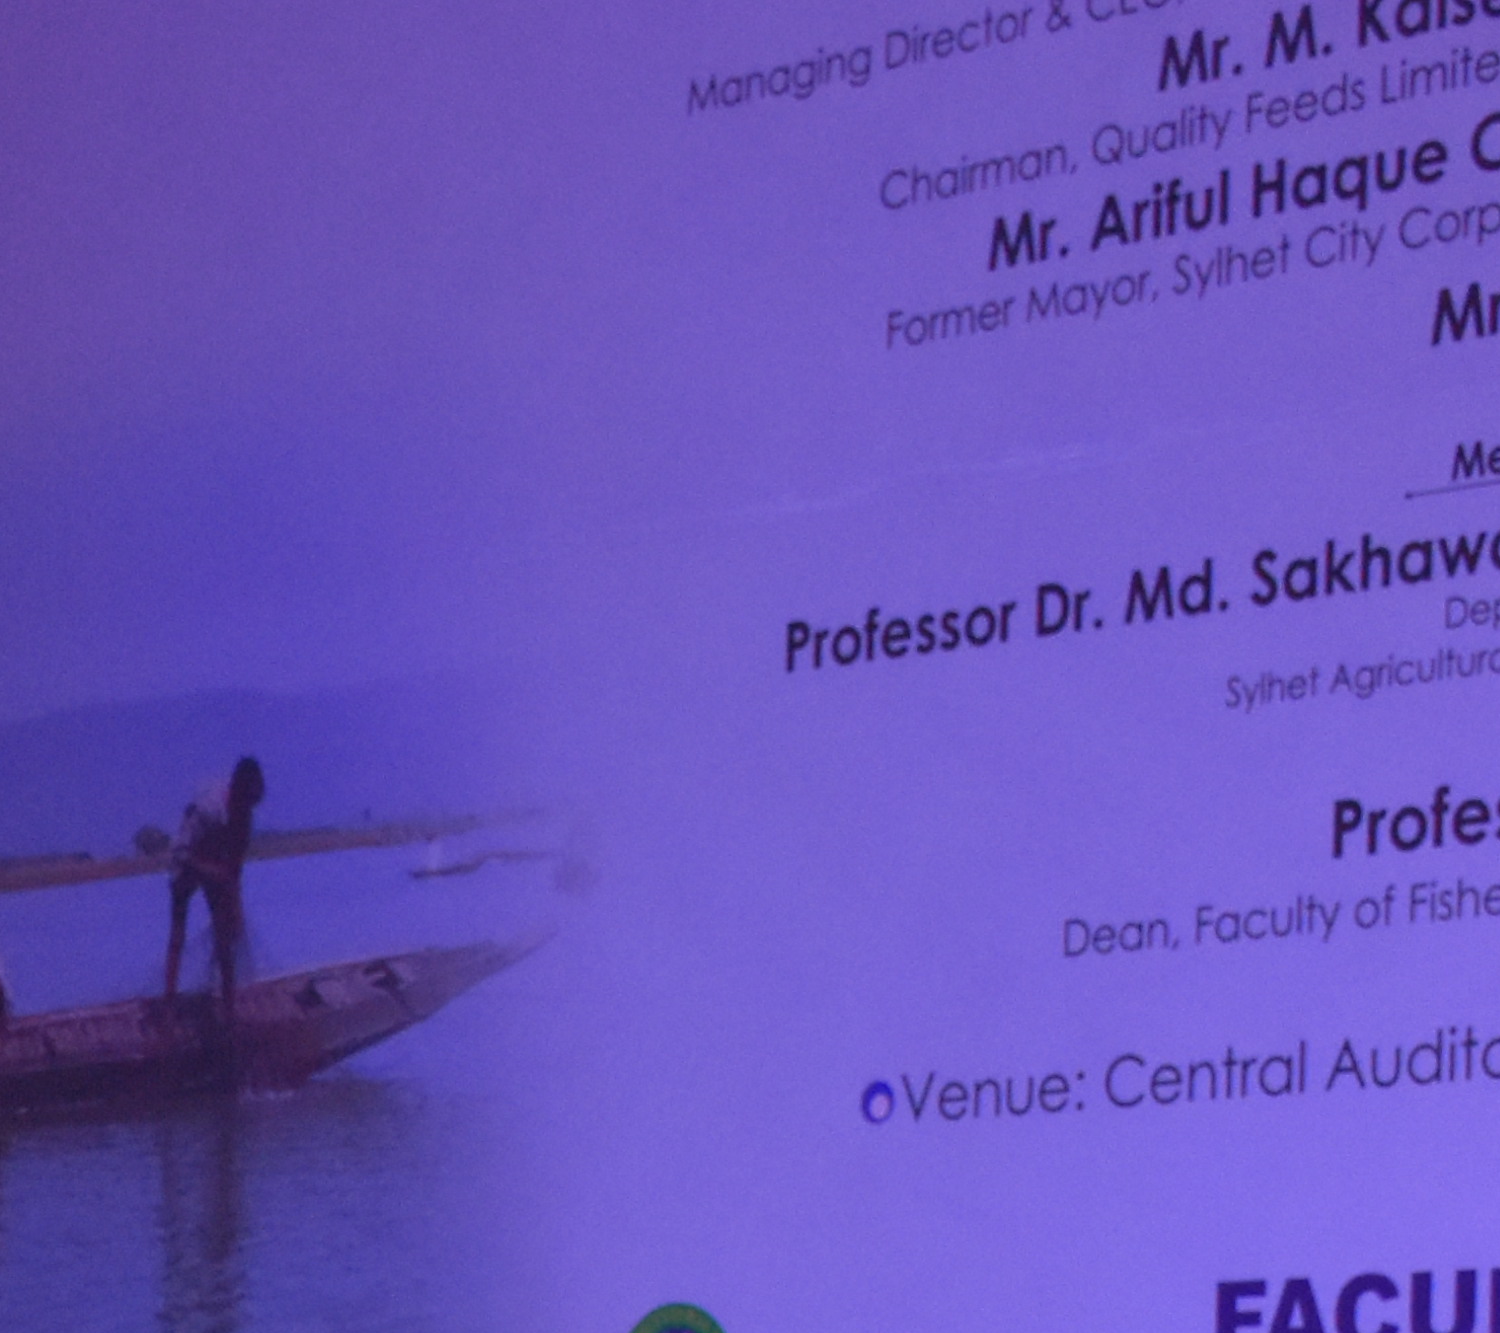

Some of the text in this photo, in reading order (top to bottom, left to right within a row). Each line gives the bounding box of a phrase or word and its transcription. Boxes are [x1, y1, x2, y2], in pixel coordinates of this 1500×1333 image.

[686, 0, 1073, 116] Managing Director &
[1157, 7, 1333, 91] Mr. M.
[880, 143, 1078, 211] Chairman,
[1092, 104, 1232, 165] Quality
[1245, 76, 1366, 134] Feeds
[987, 210, 1070, 272] Mr.
[1090, 169, 1231, 251] Ariful
[1253, 139, 1448, 217] Haque
[886, 293, 1013, 349] Former
[1026, 266, 1160, 324] Mayor,
[1173, 236, 1289, 297] Sylhet
[1305, 218, 1386, 272] City
[786, 594, 1018, 674] Professor
[1035, 579, 1104, 640] Dr.
[1125, 557, 1231, 628] Md.
[1222, 663, 1322, 711] Sylhet
[1062, 905, 1181, 959] Dean,
[1194, 888, 1343, 946] Faculty
[1353, 884, 1399, 930] of
[899, 1067, 1087, 1123] Venue:
[1103, 1037, 1308, 1110] Central
